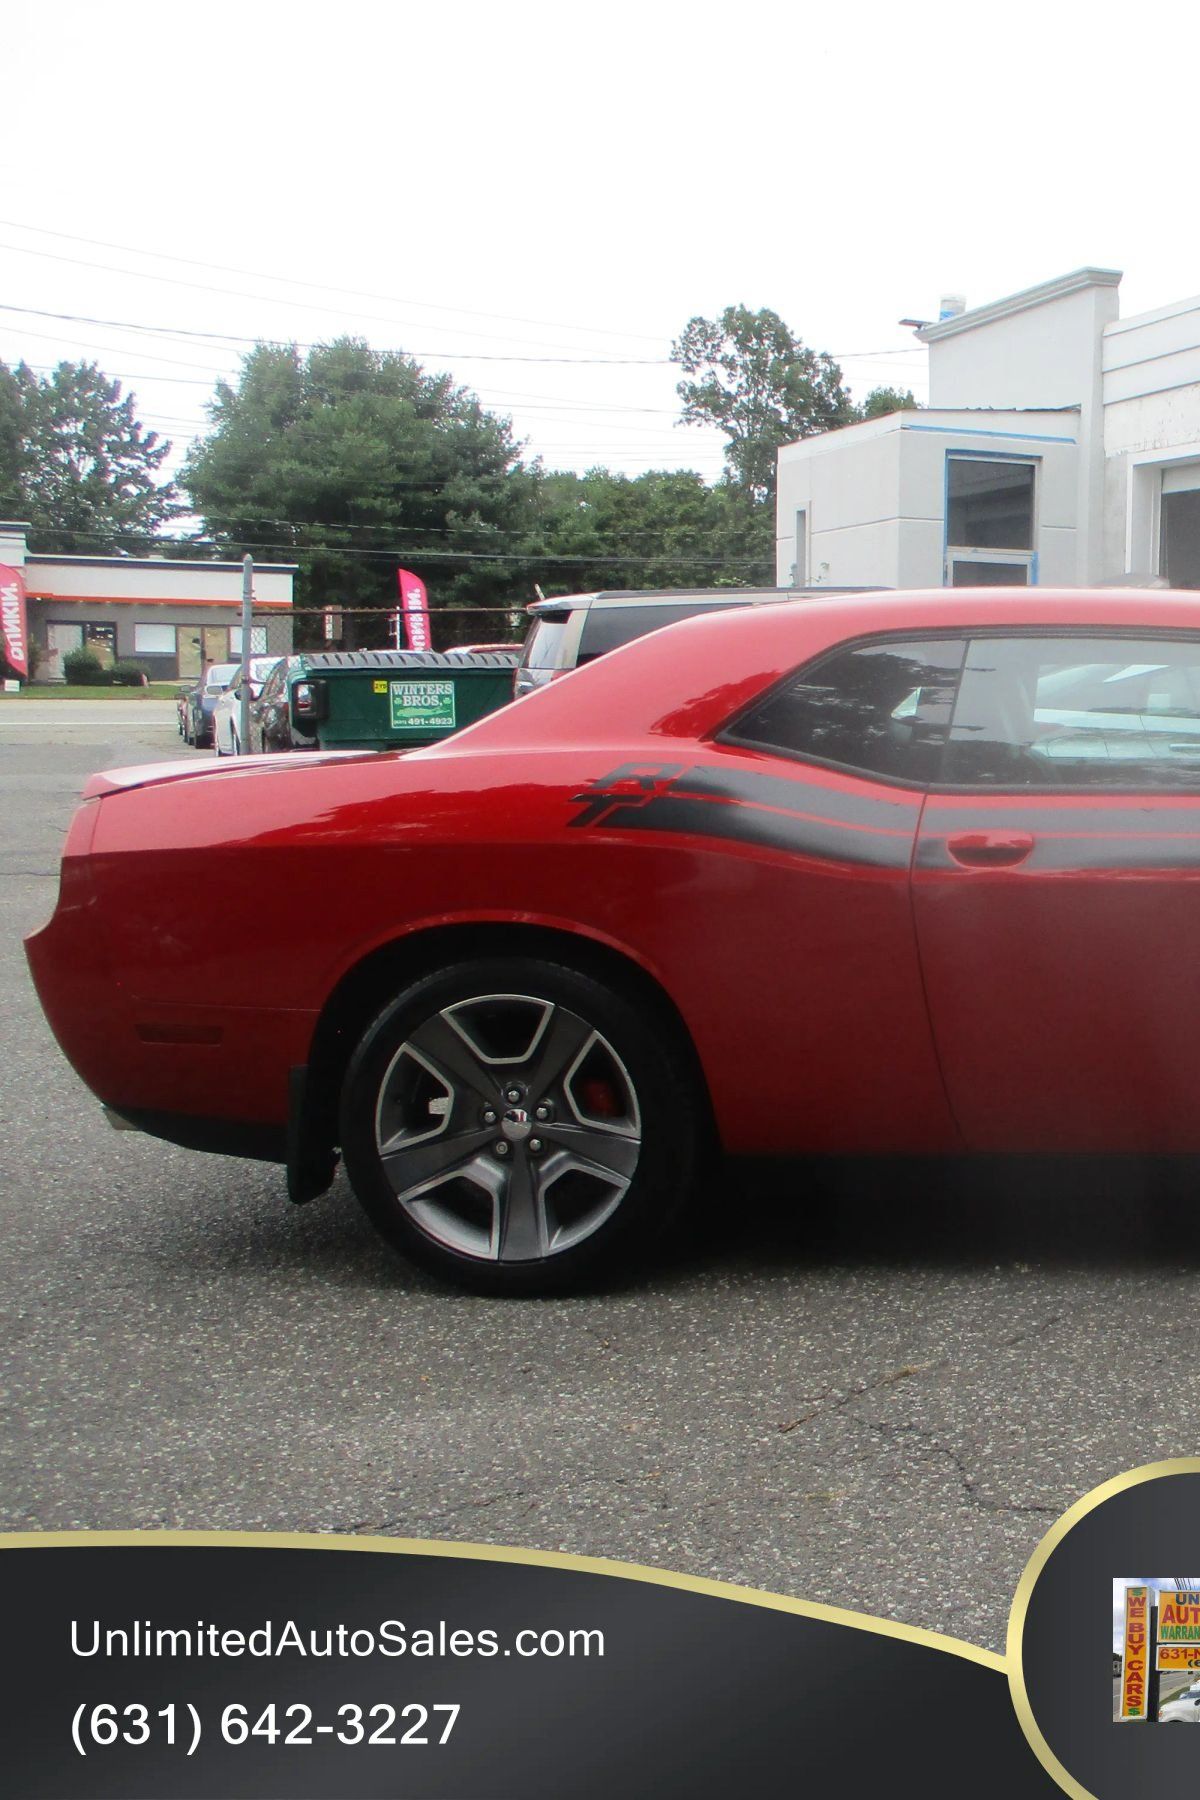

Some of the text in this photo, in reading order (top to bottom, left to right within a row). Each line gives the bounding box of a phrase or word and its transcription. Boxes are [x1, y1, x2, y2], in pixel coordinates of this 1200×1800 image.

[393, 683, 453, 695] WINTERS
[402, 695, 443, 706] BROS.
[408, 717, 453, 725] 491-4923
